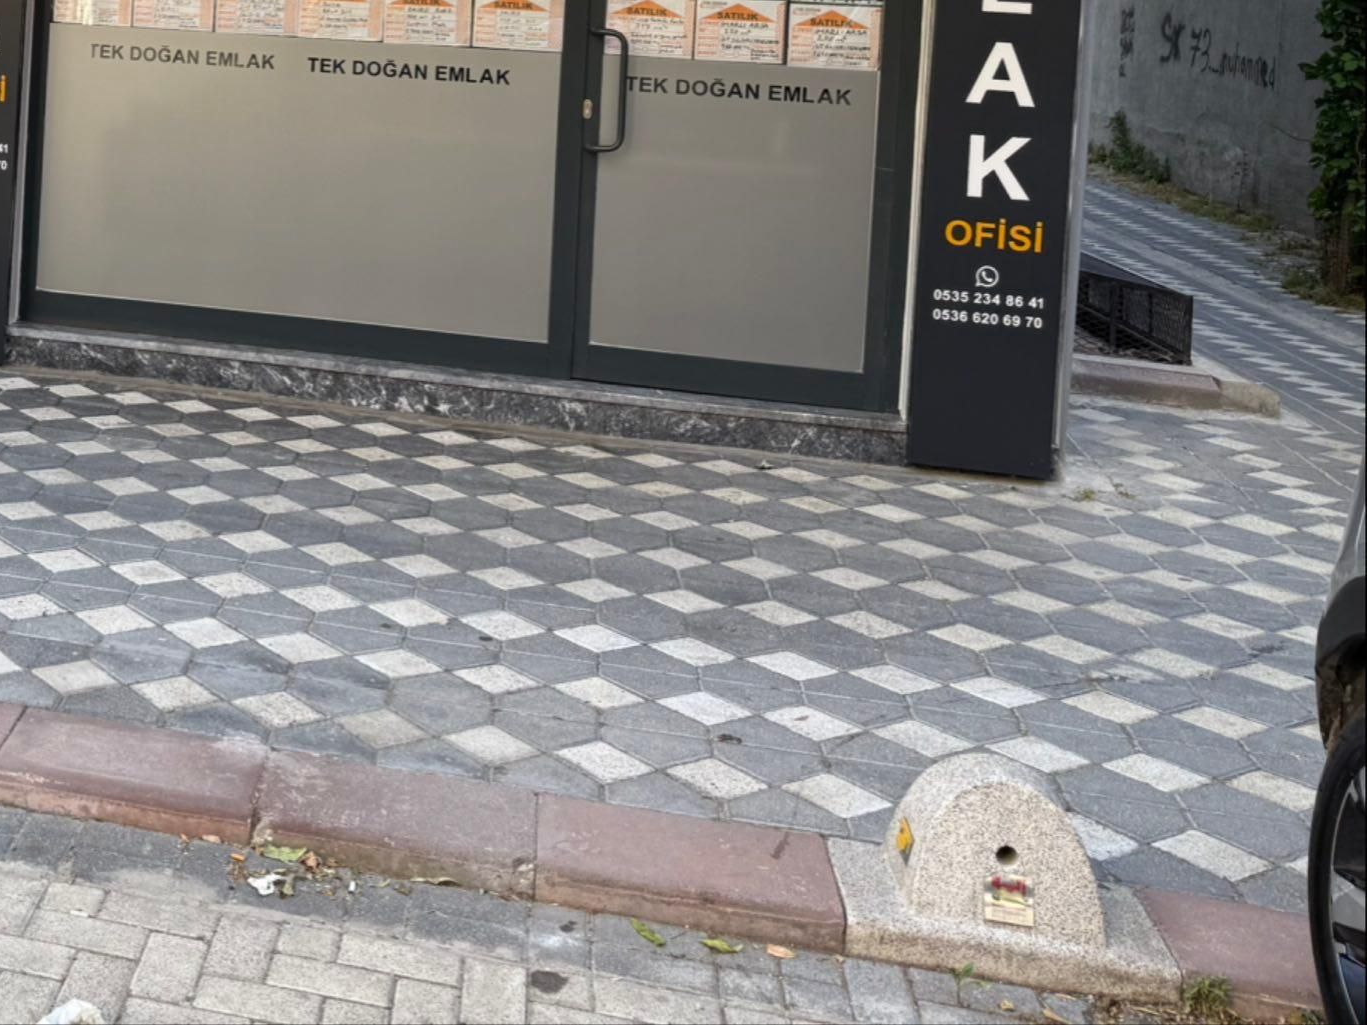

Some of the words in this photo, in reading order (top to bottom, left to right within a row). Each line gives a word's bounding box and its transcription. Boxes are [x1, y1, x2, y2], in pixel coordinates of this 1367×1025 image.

[716, 12, 759, 22] SATILIK
[91, 42, 124, 62] TEK
[129, 44, 200, 67] DOĞAN
[205, 51, 275, 71] EMLAK
[307, 56, 346, 75] TEK
[352, 59, 429, 82] DOĞAN
[434, 65, 511, 86] EMLAK
[625, 75, 669, 95] TEK
[675, 77, 761, 100] DOĞAN
[767, 84, 852, 106] EMLAK
[944, 217, 1044, 254] OFİSİ
[933, 288, 969, 303] 0535
[973, 292, 1001, 306] 234
[1005, 294, 1024, 308] 86
[1028, 296, 1044, 310] 41
[932, 308, 969, 322] 0536
[972, 311, 999, 325] 620
[1002, 314, 1021, 328] 69
[1025, 316, 1043, 329] 70
